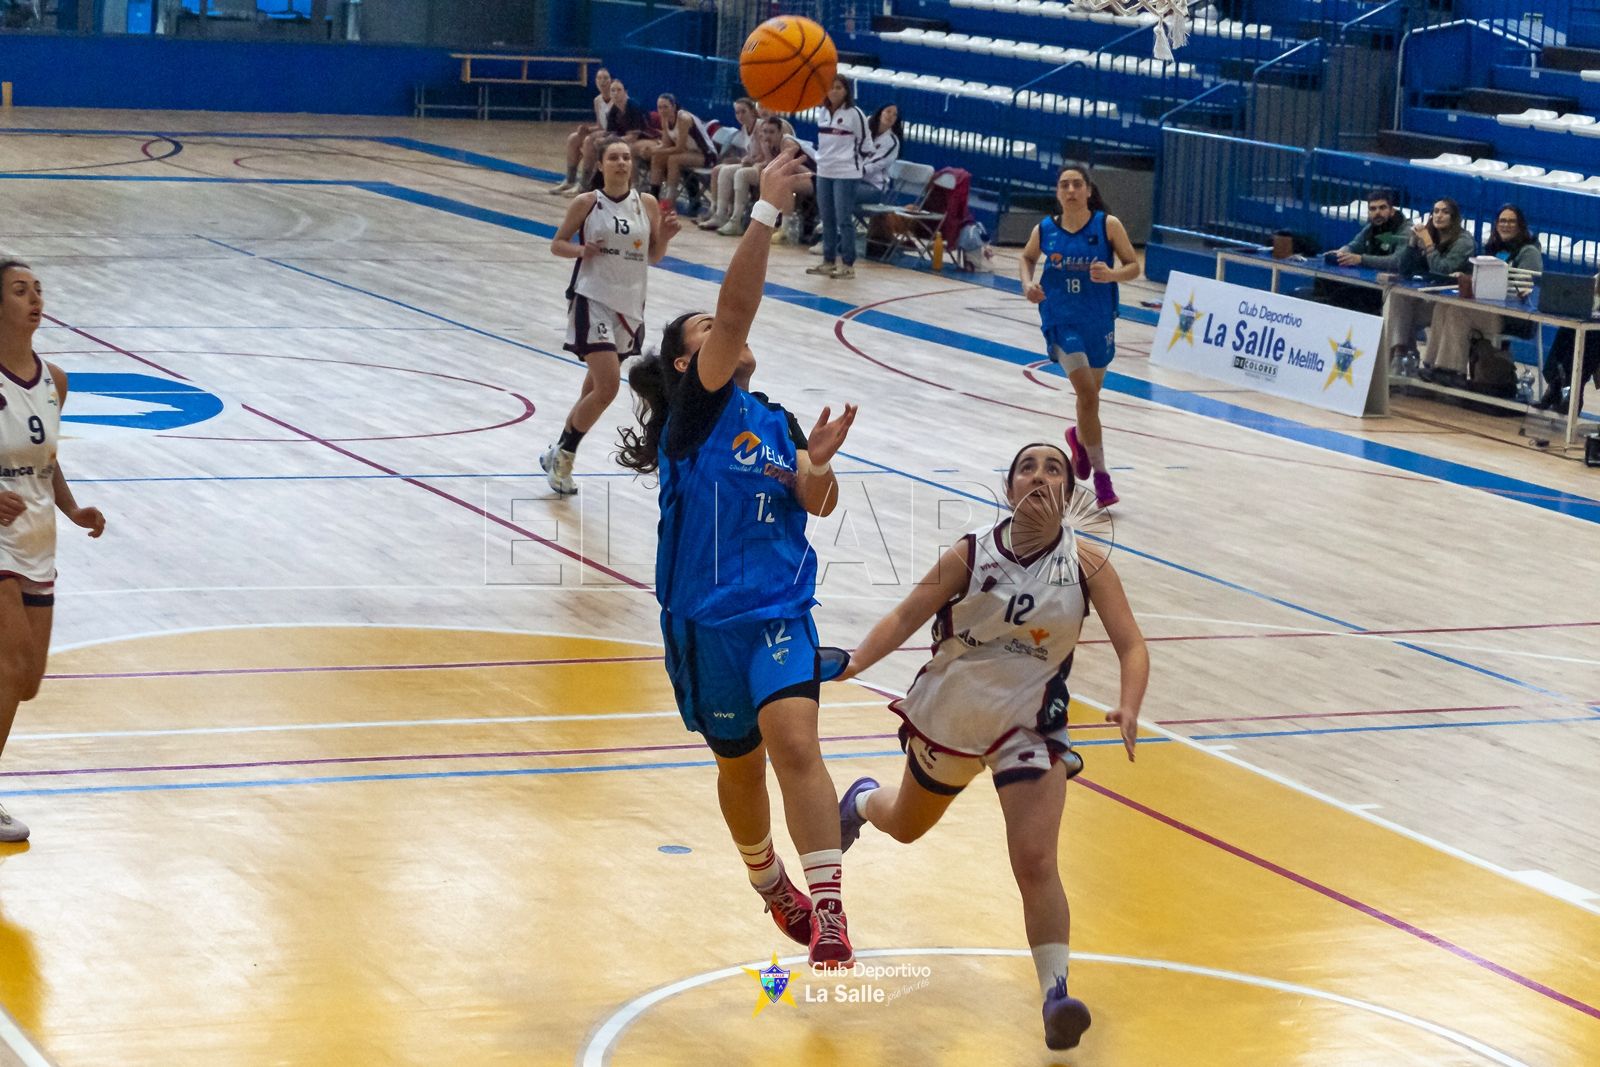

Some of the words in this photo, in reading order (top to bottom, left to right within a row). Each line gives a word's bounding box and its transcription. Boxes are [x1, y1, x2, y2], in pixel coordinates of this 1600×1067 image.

[613, 215, 630, 235] 13
[1065, 278, 1081, 294] 18
[1238, 300, 1259, 318] Club
[1258, 305, 1303, 329] Deportivo
[1203, 313, 1228, 348] La
[1231, 319, 1286, 362] Salle
[1287, 346, 1325, 373] Melilla
[28, 415, 46, 445] 9
[1003, 593, 1035, 626] 12
[763, 620, 792, 648] 12
[713, 711, 736, 719] vive
